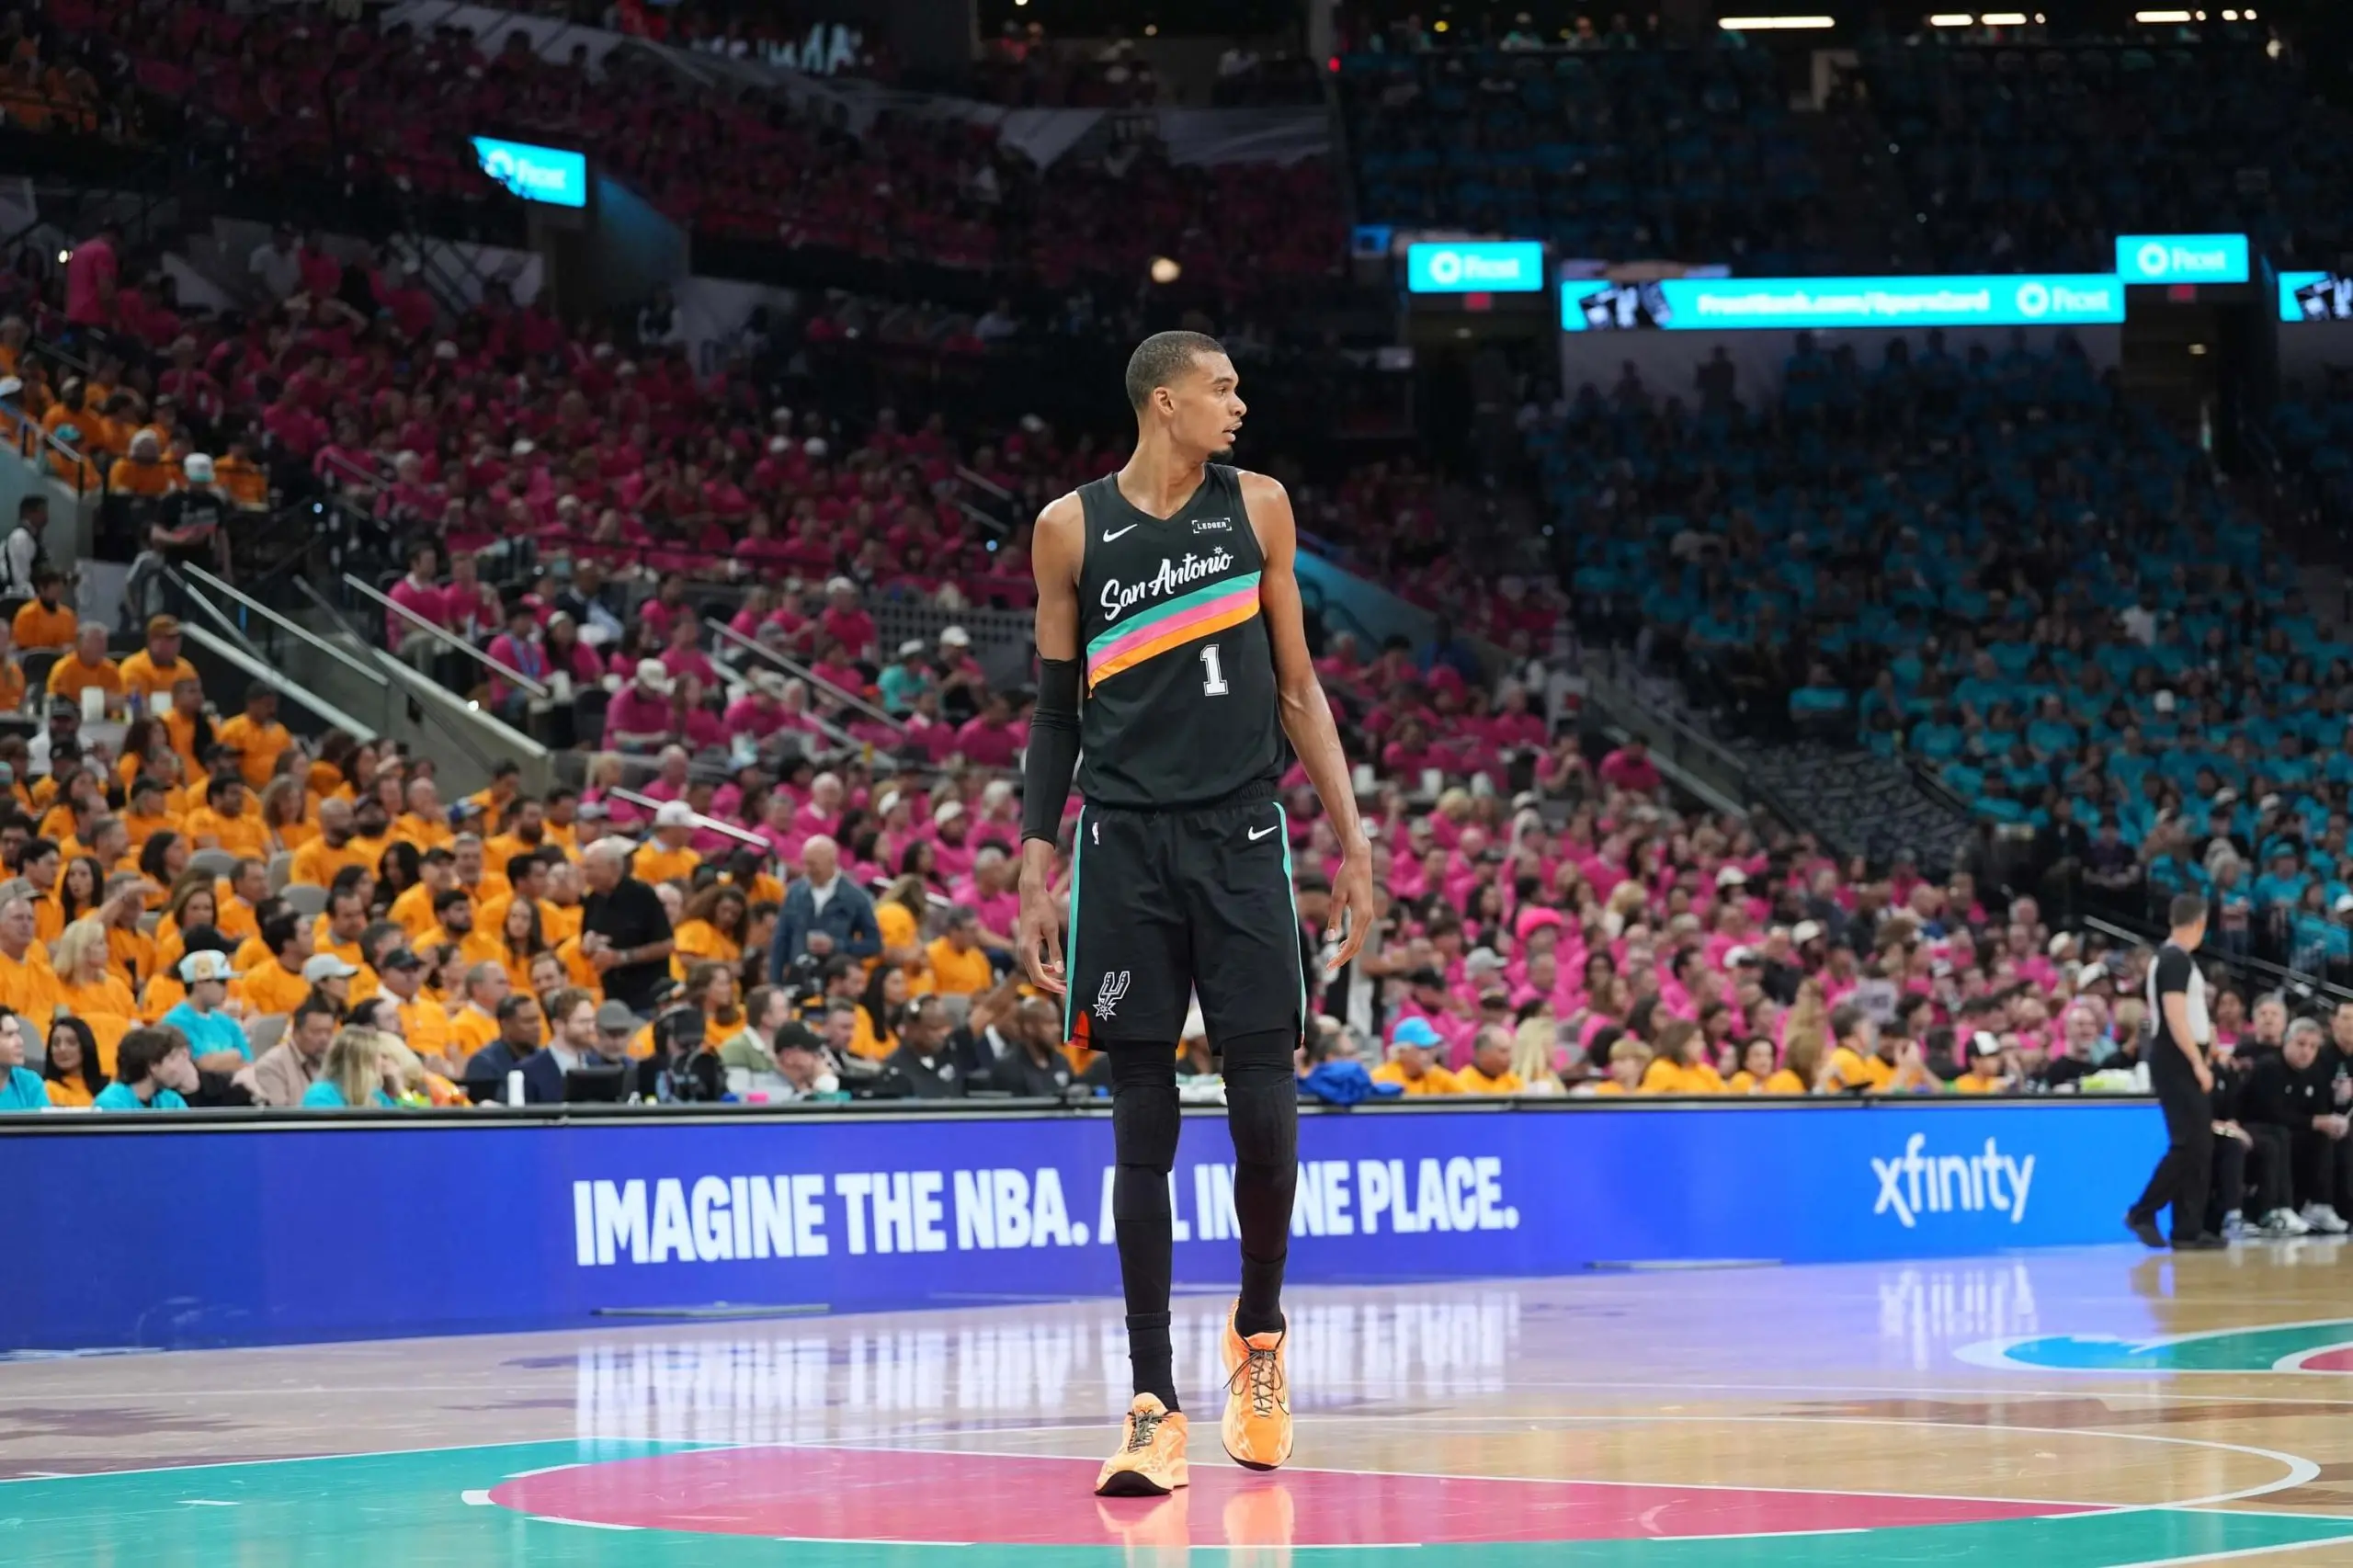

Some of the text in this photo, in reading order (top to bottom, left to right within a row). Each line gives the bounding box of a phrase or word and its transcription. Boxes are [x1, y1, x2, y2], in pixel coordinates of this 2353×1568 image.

[1197, 521, 1227, 530] LEDGER
[1100, 546, 1233, 621] San Antonio
[1199, 643, 1229, 697] 1
[574, 1174, 829, 1266] IMAGINE
[835, 1171, 947, 1255] THE
[953, 1167, 1089, 1250] NBA.
[1290, 1160, 1354, 1236] NE
[1358, 1156, 1519, 1234] PLACE.
[1870, 1131, 2036, 1228] xfinity
